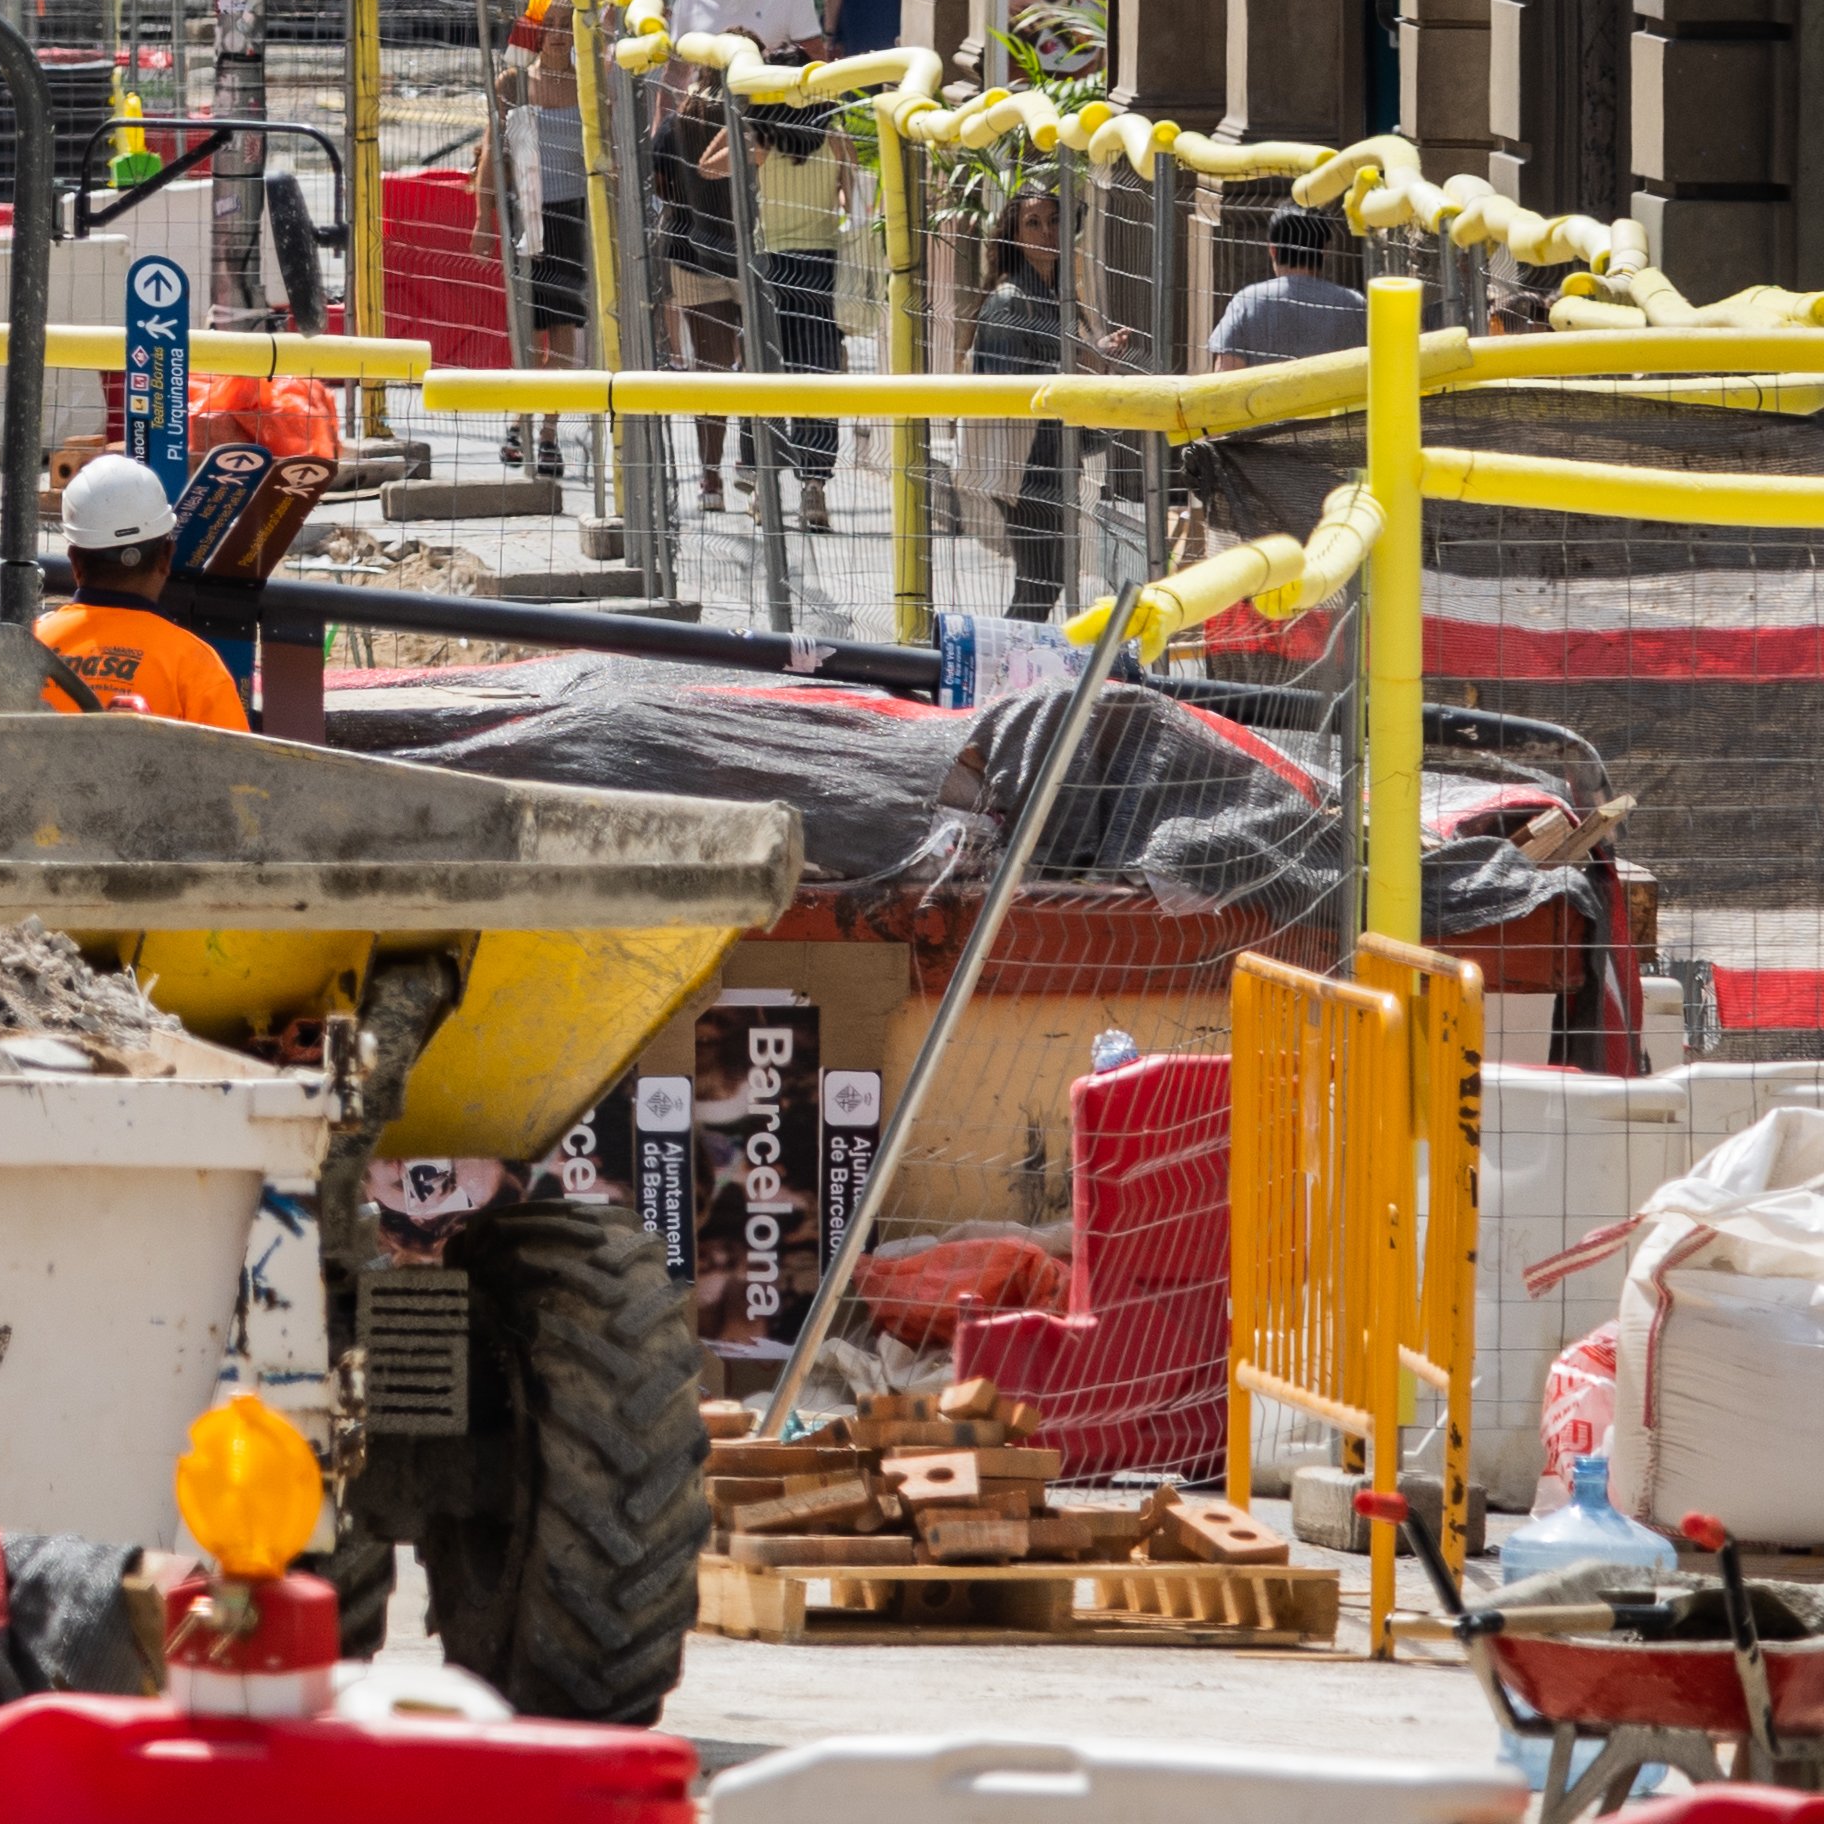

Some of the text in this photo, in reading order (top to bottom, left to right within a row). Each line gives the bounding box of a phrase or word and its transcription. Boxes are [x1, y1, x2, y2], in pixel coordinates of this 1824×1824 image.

[151, 345, 165, 430] Teatre Borràs
[167, 348, 187, 461] Pl. Urquinaona
[642, 1143, 660, 1232] de Barce
[661, 1141, 685, 1268] Ajuntament
[746, 1026, 794, 1320] Barcelona
[832, 1138, 849, 1170] de
